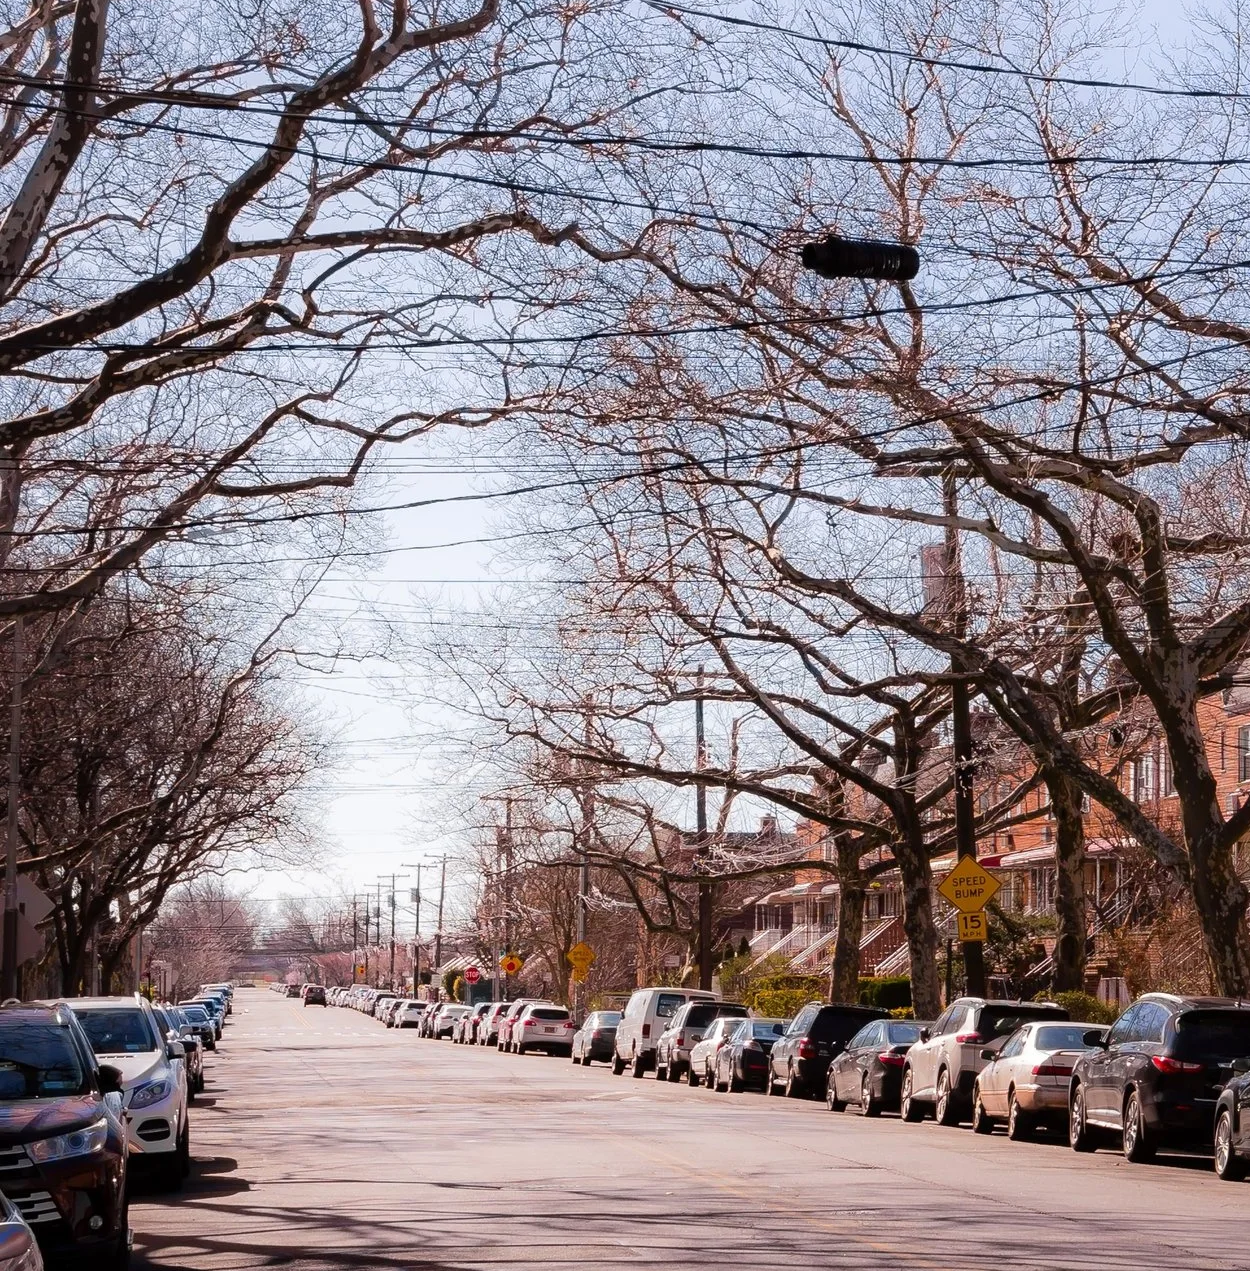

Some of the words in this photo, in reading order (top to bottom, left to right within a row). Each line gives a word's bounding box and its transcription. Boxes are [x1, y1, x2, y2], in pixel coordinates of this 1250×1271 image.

[952, 876, 986, 887] SPEED
[955, 888, 985, 899] BUMP
[962, 915, 981, 929] 15
